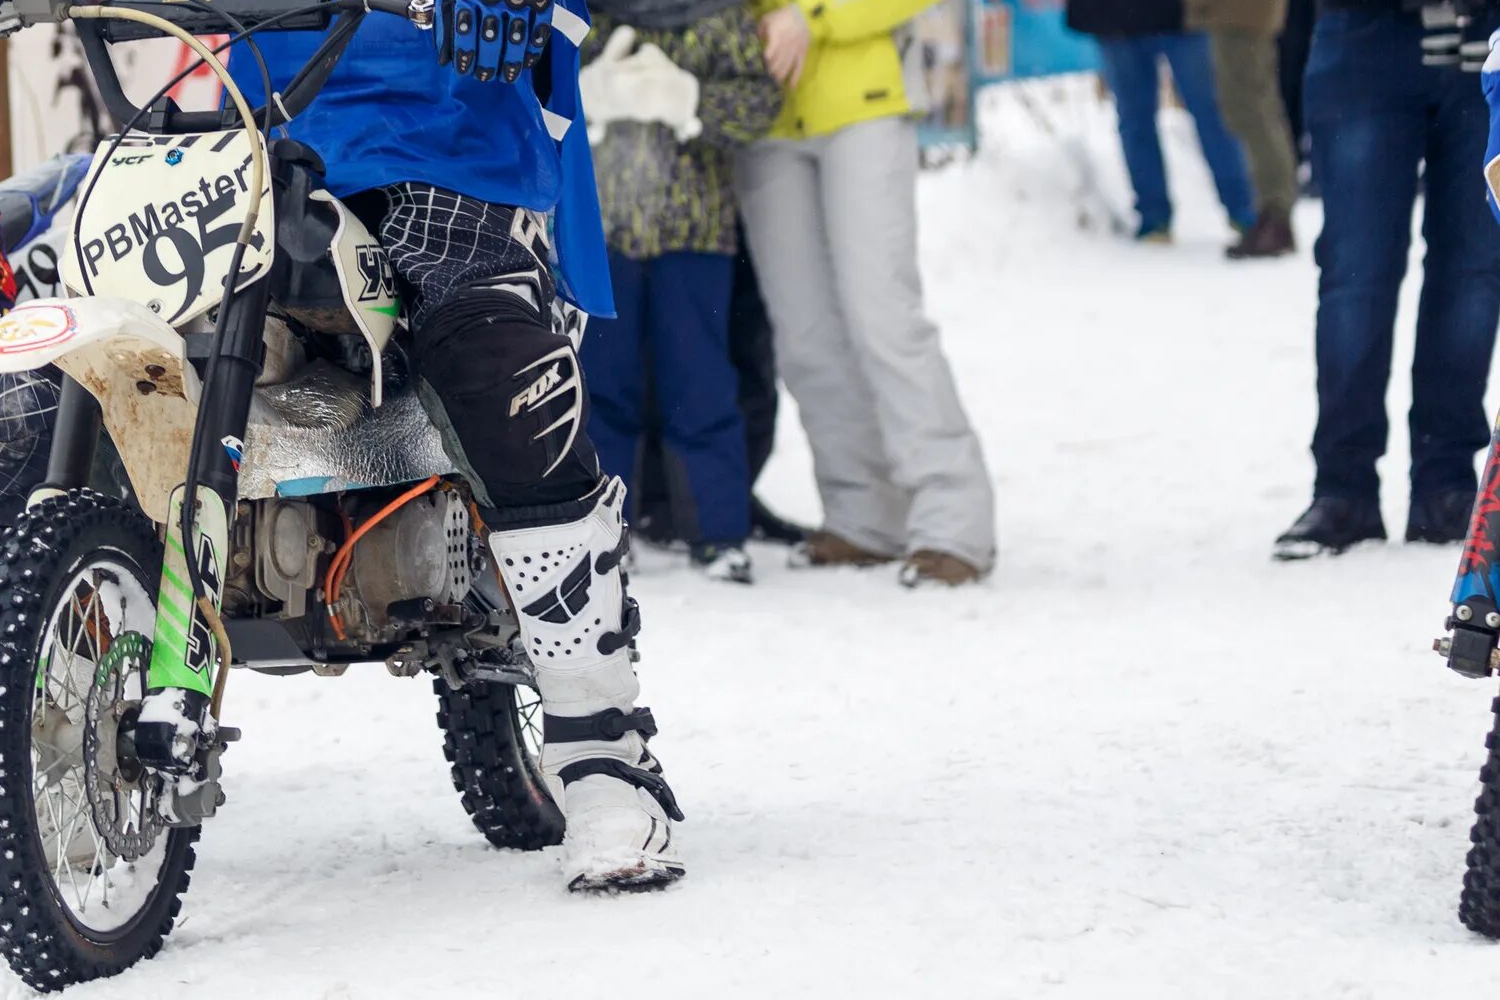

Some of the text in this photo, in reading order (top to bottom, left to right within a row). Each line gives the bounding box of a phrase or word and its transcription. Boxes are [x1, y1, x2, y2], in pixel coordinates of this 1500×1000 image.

[82, 152, 254, 278] PBMaster
[142, 188, 267, 324] 95
[509, 361, 562, 417] FOX
